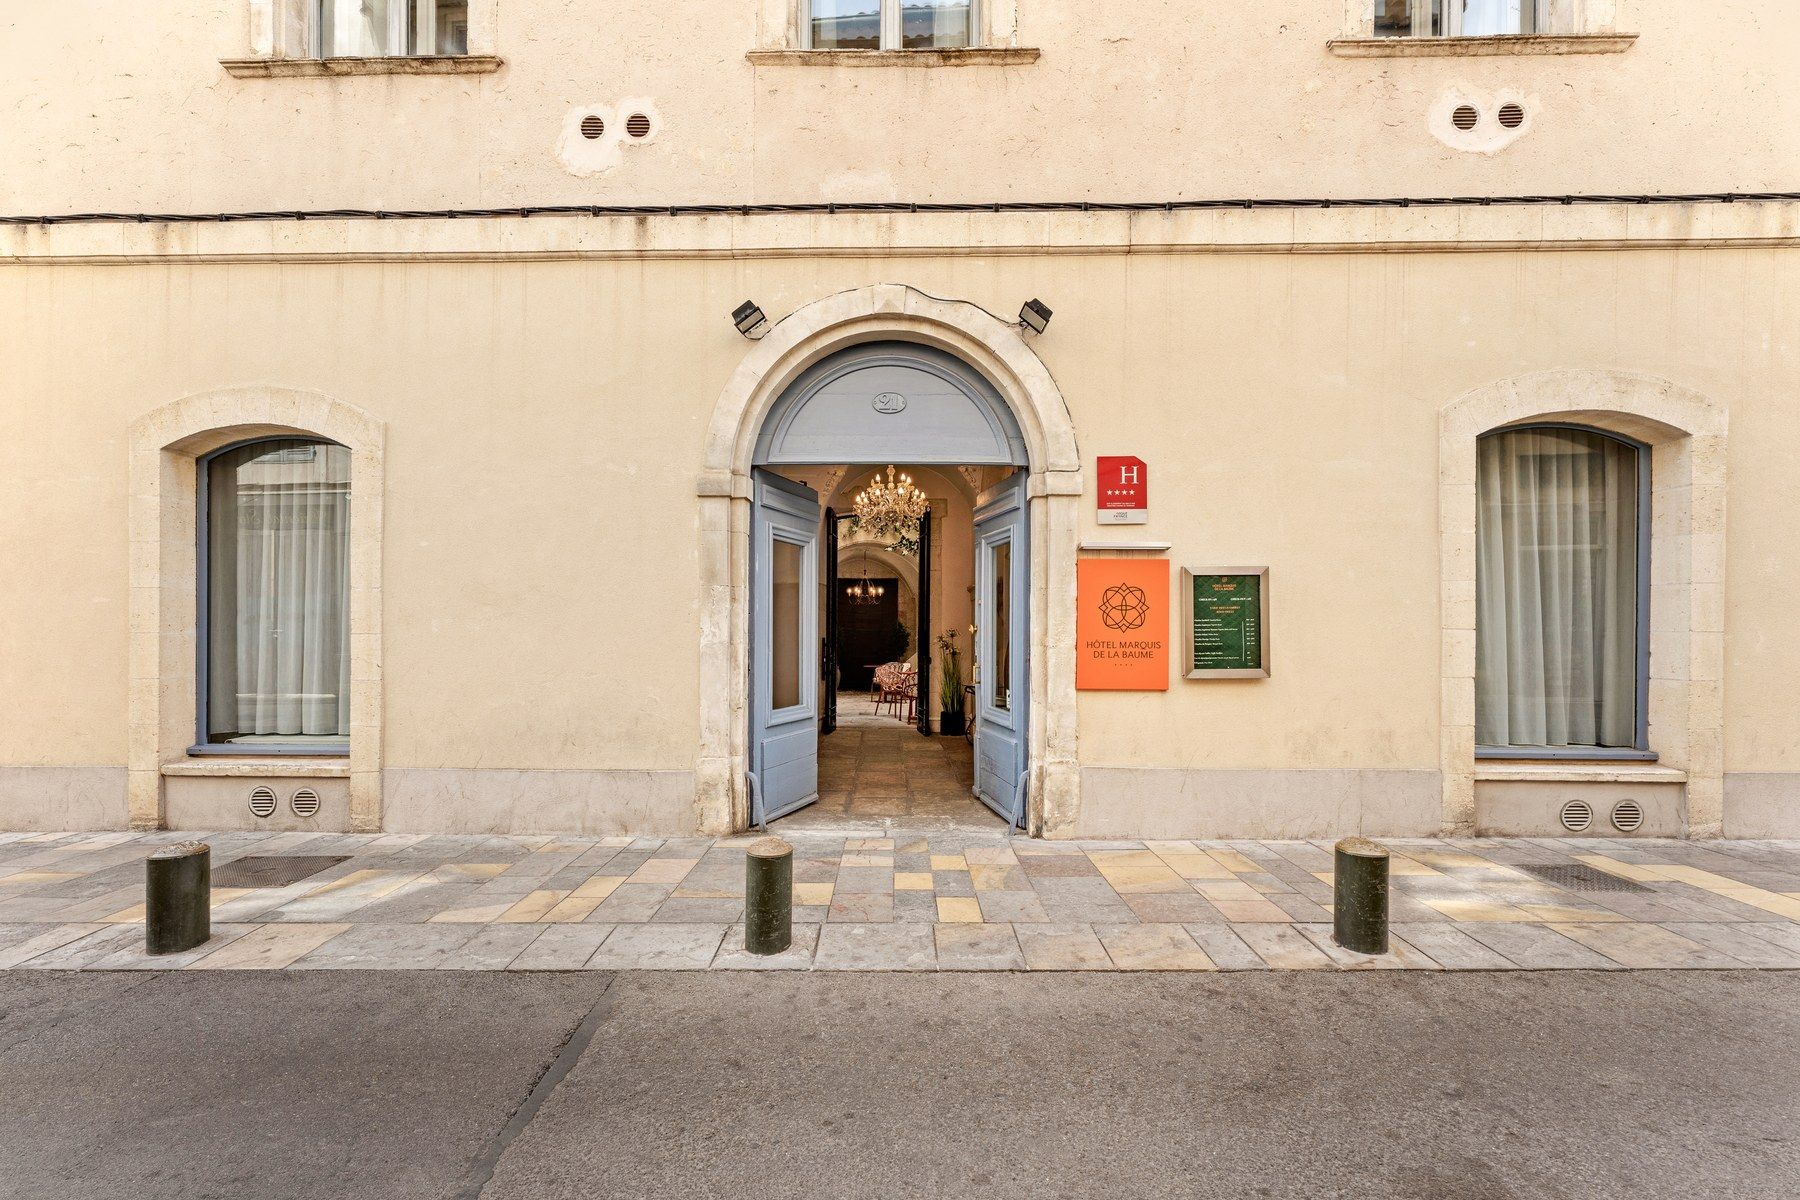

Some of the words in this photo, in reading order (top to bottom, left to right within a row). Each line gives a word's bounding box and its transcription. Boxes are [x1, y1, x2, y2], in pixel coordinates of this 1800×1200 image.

[1120, 465, 1139, 485] H
[1086, 639, 1117, 649] HÔTEL
[1119, 641, 1161, 650] MARQUIS
[1093, 650, 1105, 659] DE
[1107, 650, 1119, 659] LA
[1122, 650, 1154, 659] BAUME
